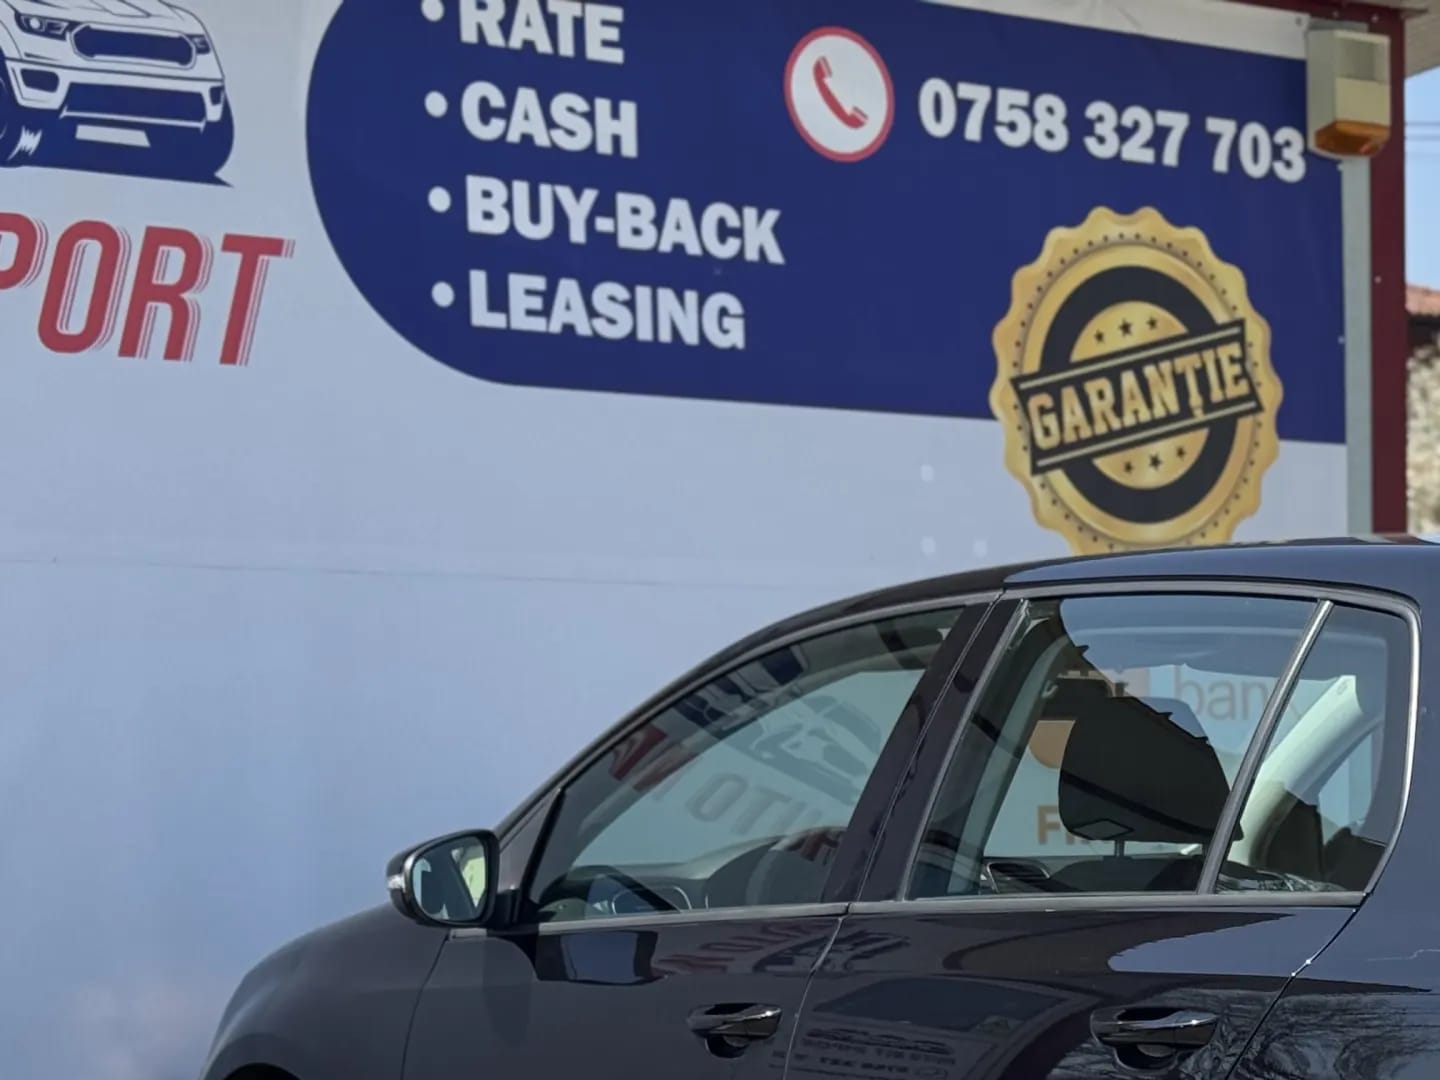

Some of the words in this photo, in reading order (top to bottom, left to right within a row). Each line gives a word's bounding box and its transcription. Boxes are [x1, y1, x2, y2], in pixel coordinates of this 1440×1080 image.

[459, 0, 625, 64] RATE
[461, 81, 638, 158] CASH
[918, 77, 1069, 152] 0758
[1084, 101, 1190, 168] 327
[1204, 117, 1306, 183] 703
[465, 175, 785, 265] BUY-BACK
[469, 270, 745, 349] LEASING
